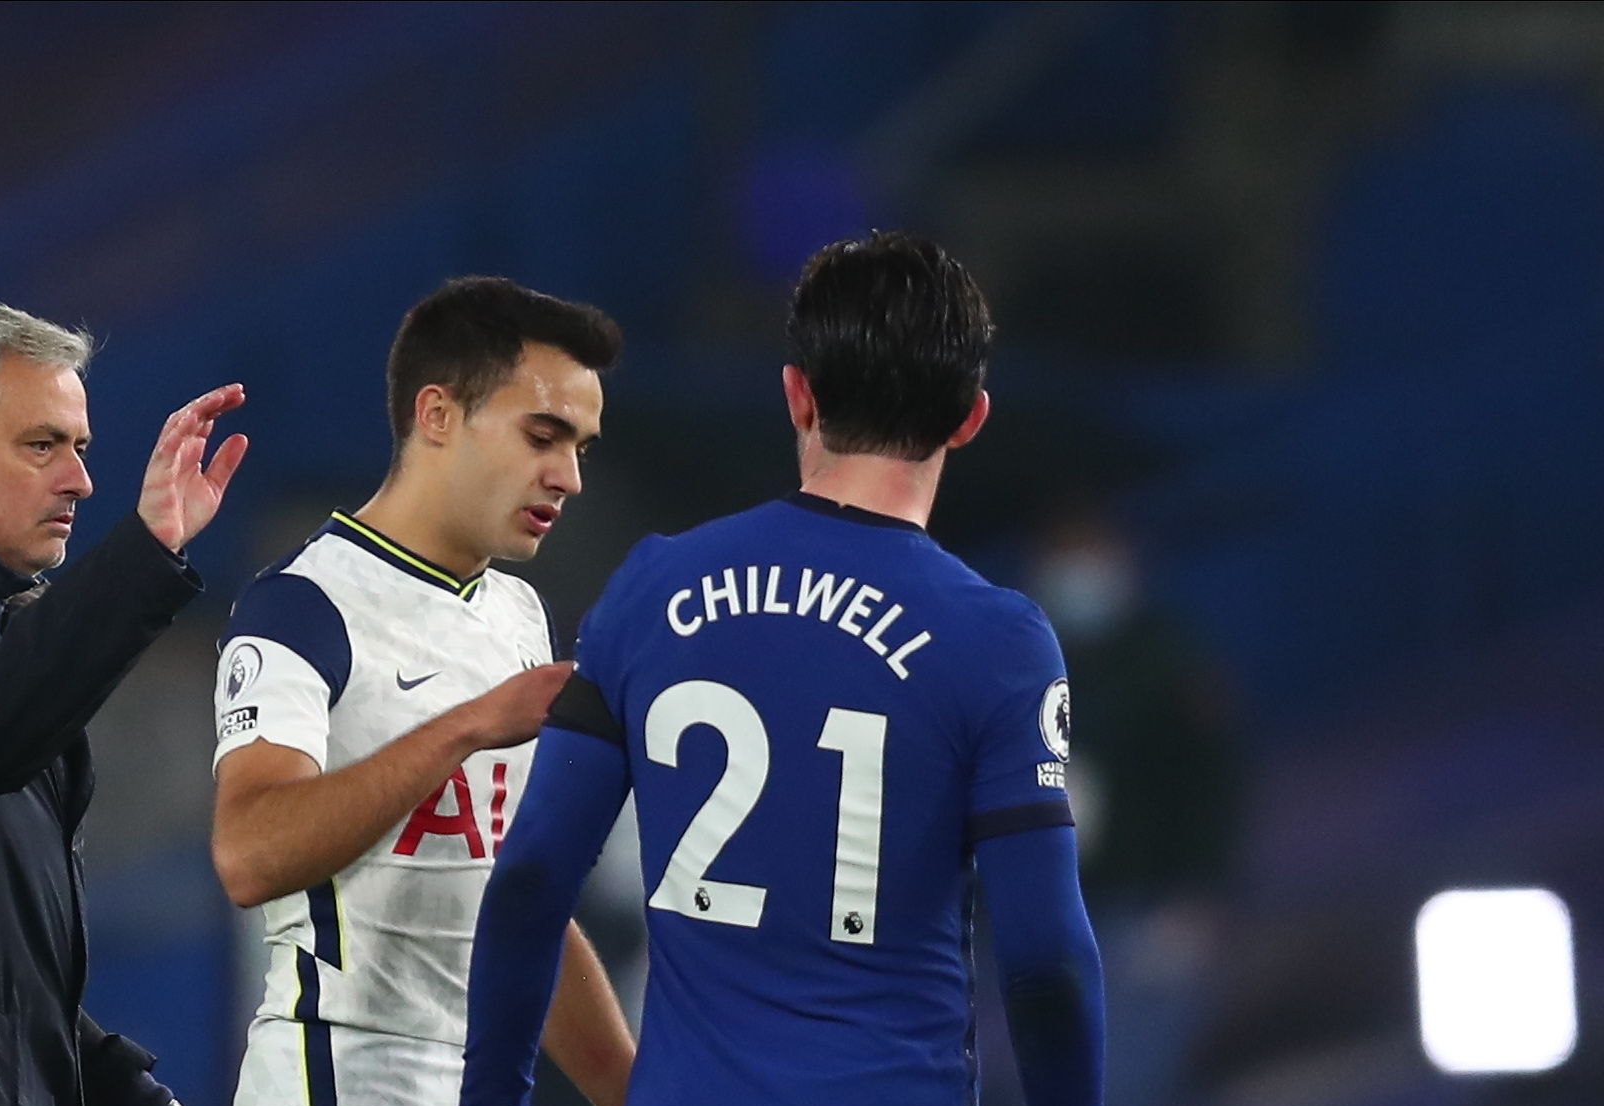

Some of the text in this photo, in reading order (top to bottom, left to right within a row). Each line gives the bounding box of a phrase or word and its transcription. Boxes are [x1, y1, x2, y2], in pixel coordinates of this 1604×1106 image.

[666, 565, 932, 681] CHILWELL
[392, 763, 508, 859] AI
[644, 679, 888, 945] 21
